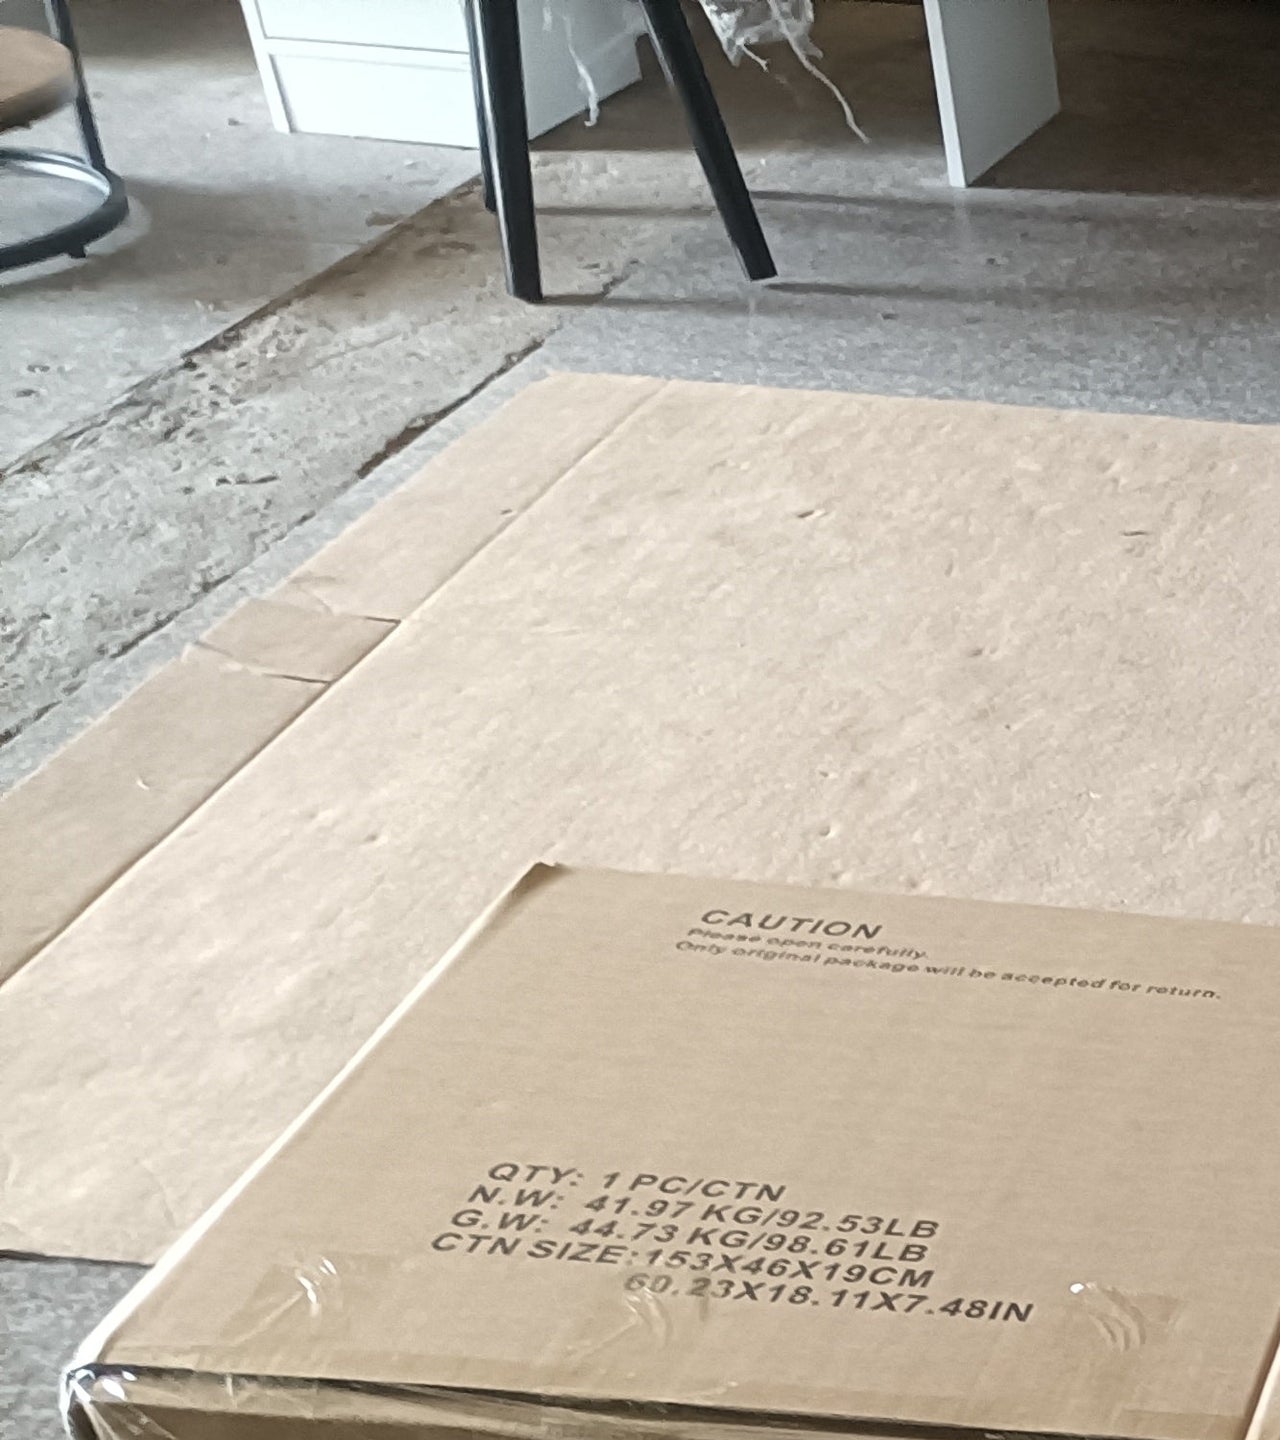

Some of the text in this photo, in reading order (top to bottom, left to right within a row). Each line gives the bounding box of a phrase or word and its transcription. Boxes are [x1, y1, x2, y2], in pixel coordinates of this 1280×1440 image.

[687, 928, 929, 959] Please open carefully.
[701, 910, 883, 939] CAUTION
[675, 940, 1221, 999] Only original package will be accepted for return.
[487, 1162, 786, 1202] QTY: 1 PC/CTN
[467, 1184, 940, 1239] N.W: 41.97 KG/92.53LB
[430, 1232, 522, 1255] CTN
[450, 1208, 929, 1263] G.W: 44.73 KG/98.61LB
[623, 1273, 1034, 1323] 60.23X18.11X7.48IN
